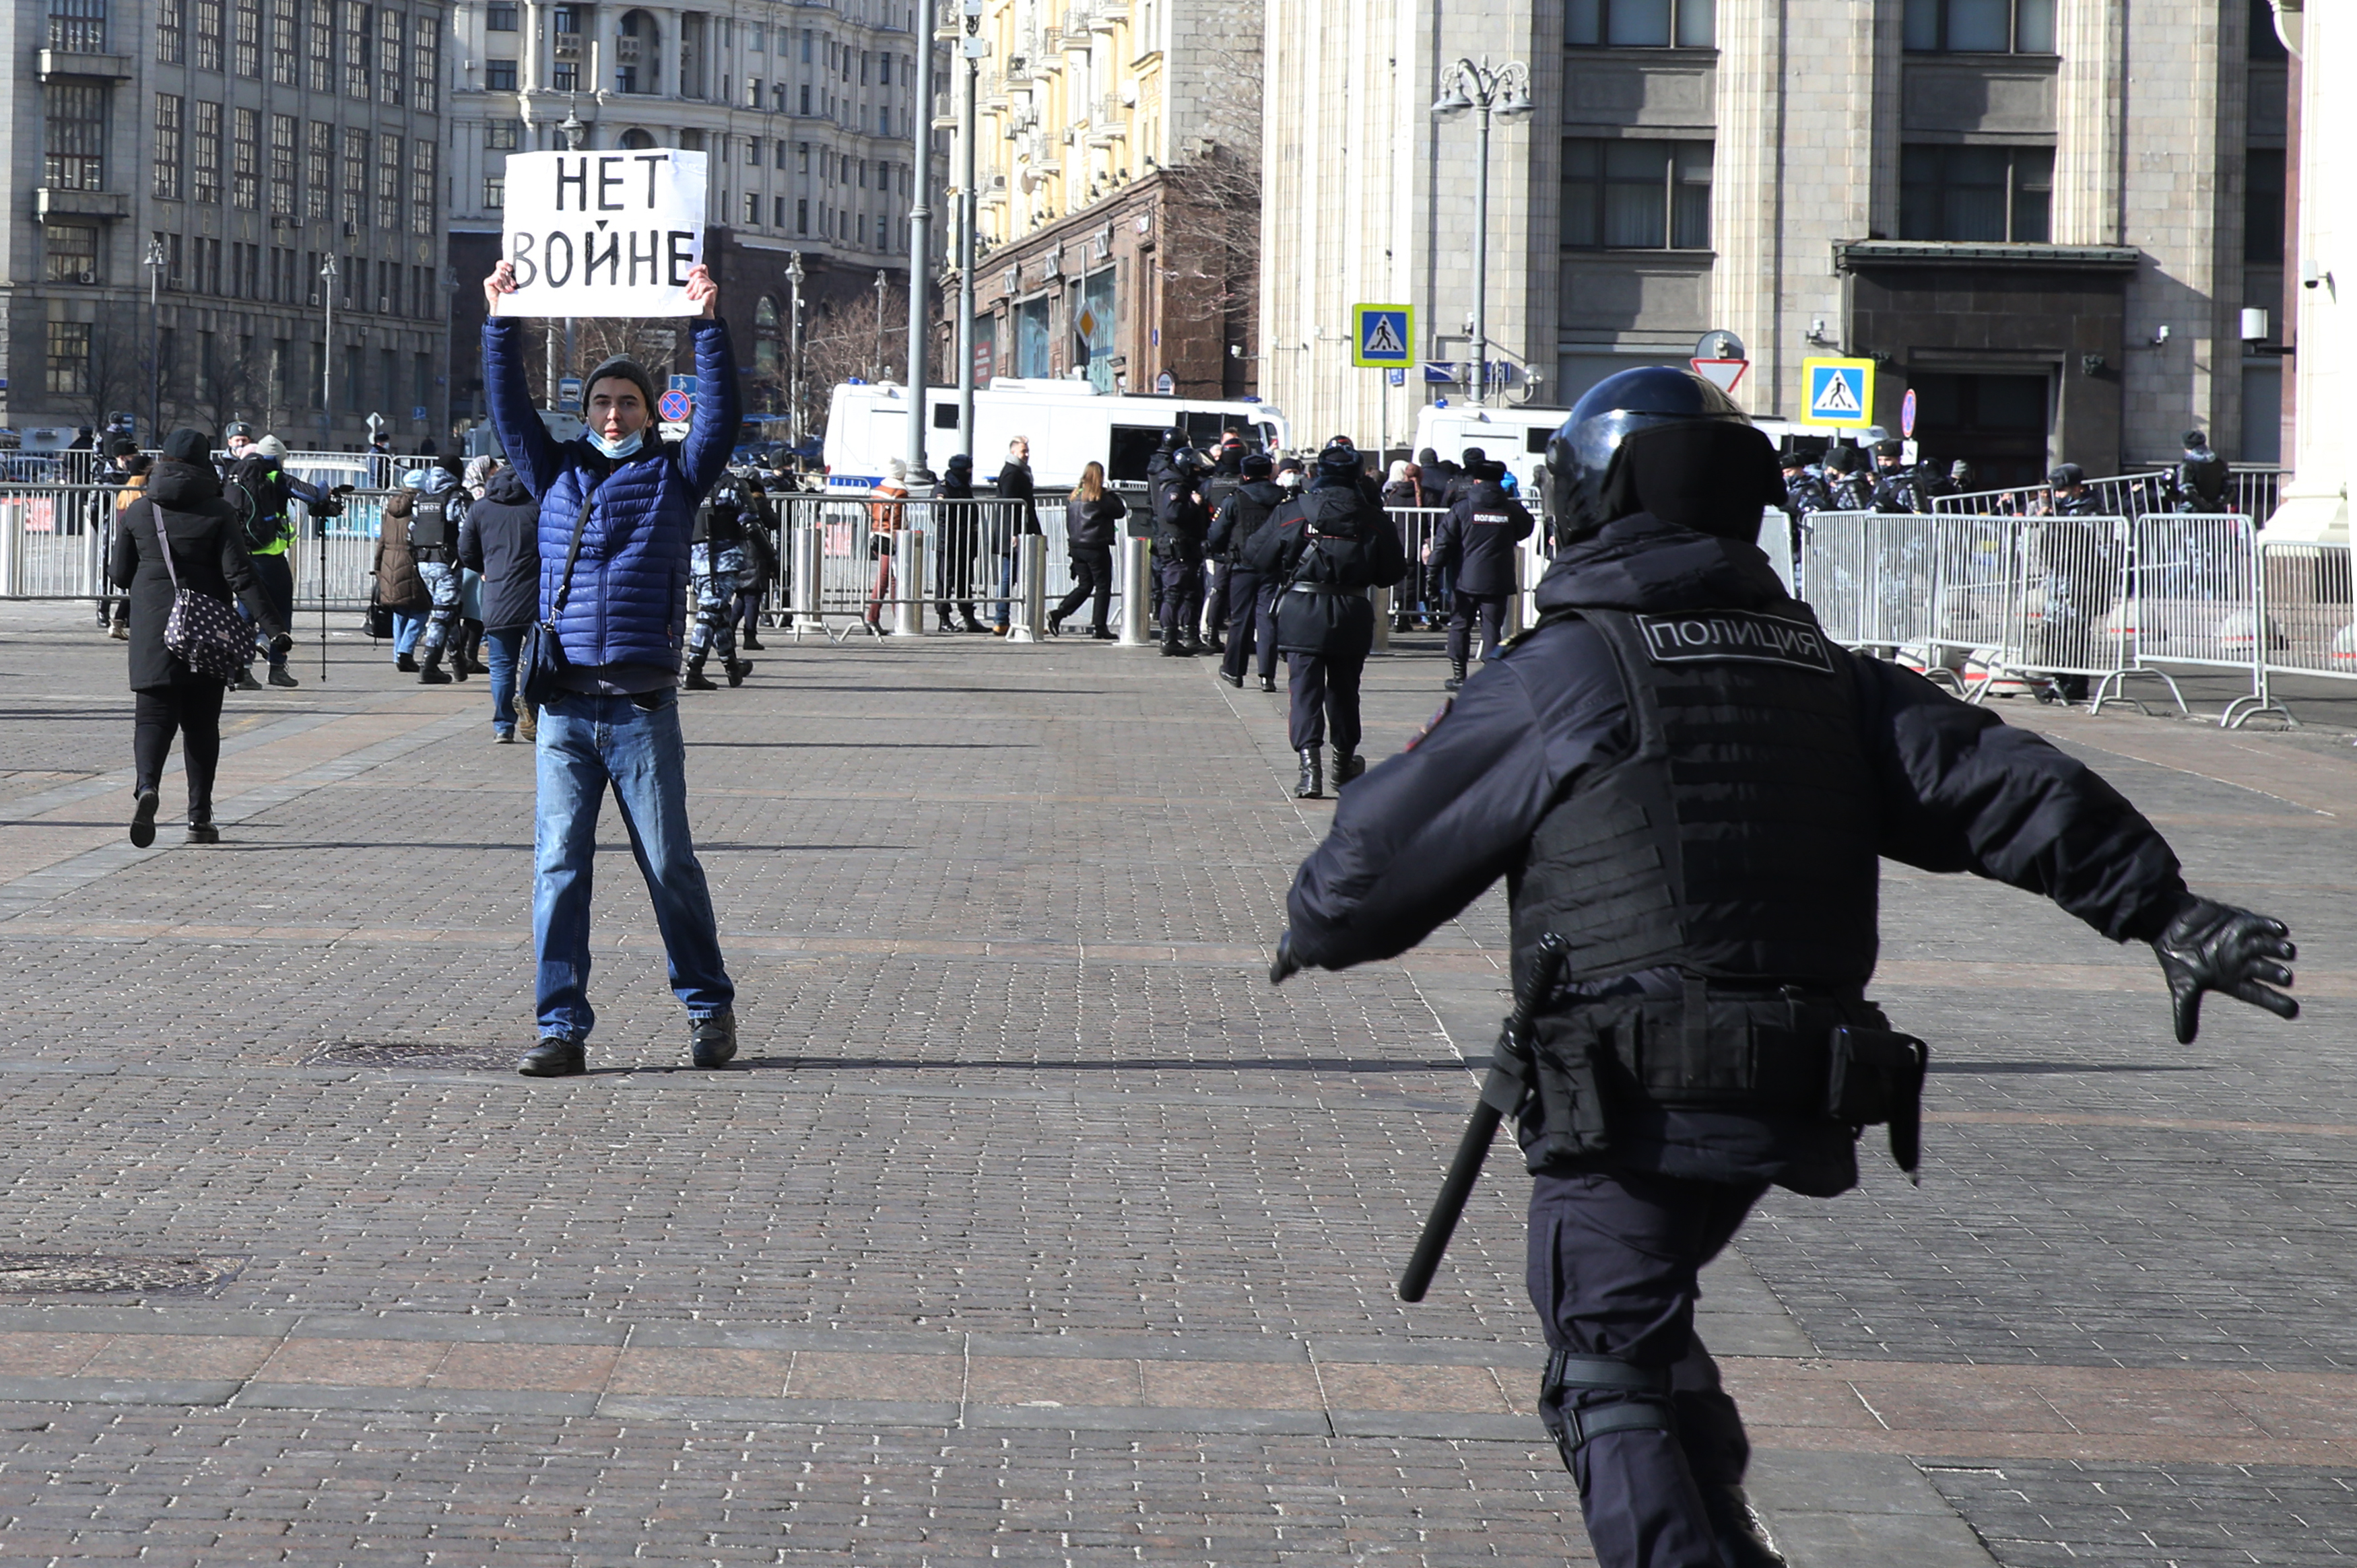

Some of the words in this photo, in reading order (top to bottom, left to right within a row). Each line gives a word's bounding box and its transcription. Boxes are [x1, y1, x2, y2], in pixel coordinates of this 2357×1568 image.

[556, 155, 668, 211] НЕТ
[162, 204, 428, 262] ТЕЛЕГРАФ
[512, 219, 694, 289] ВОЙНЕ
[1650, 619, 1822, 658] ПОЛИЦИЯ
